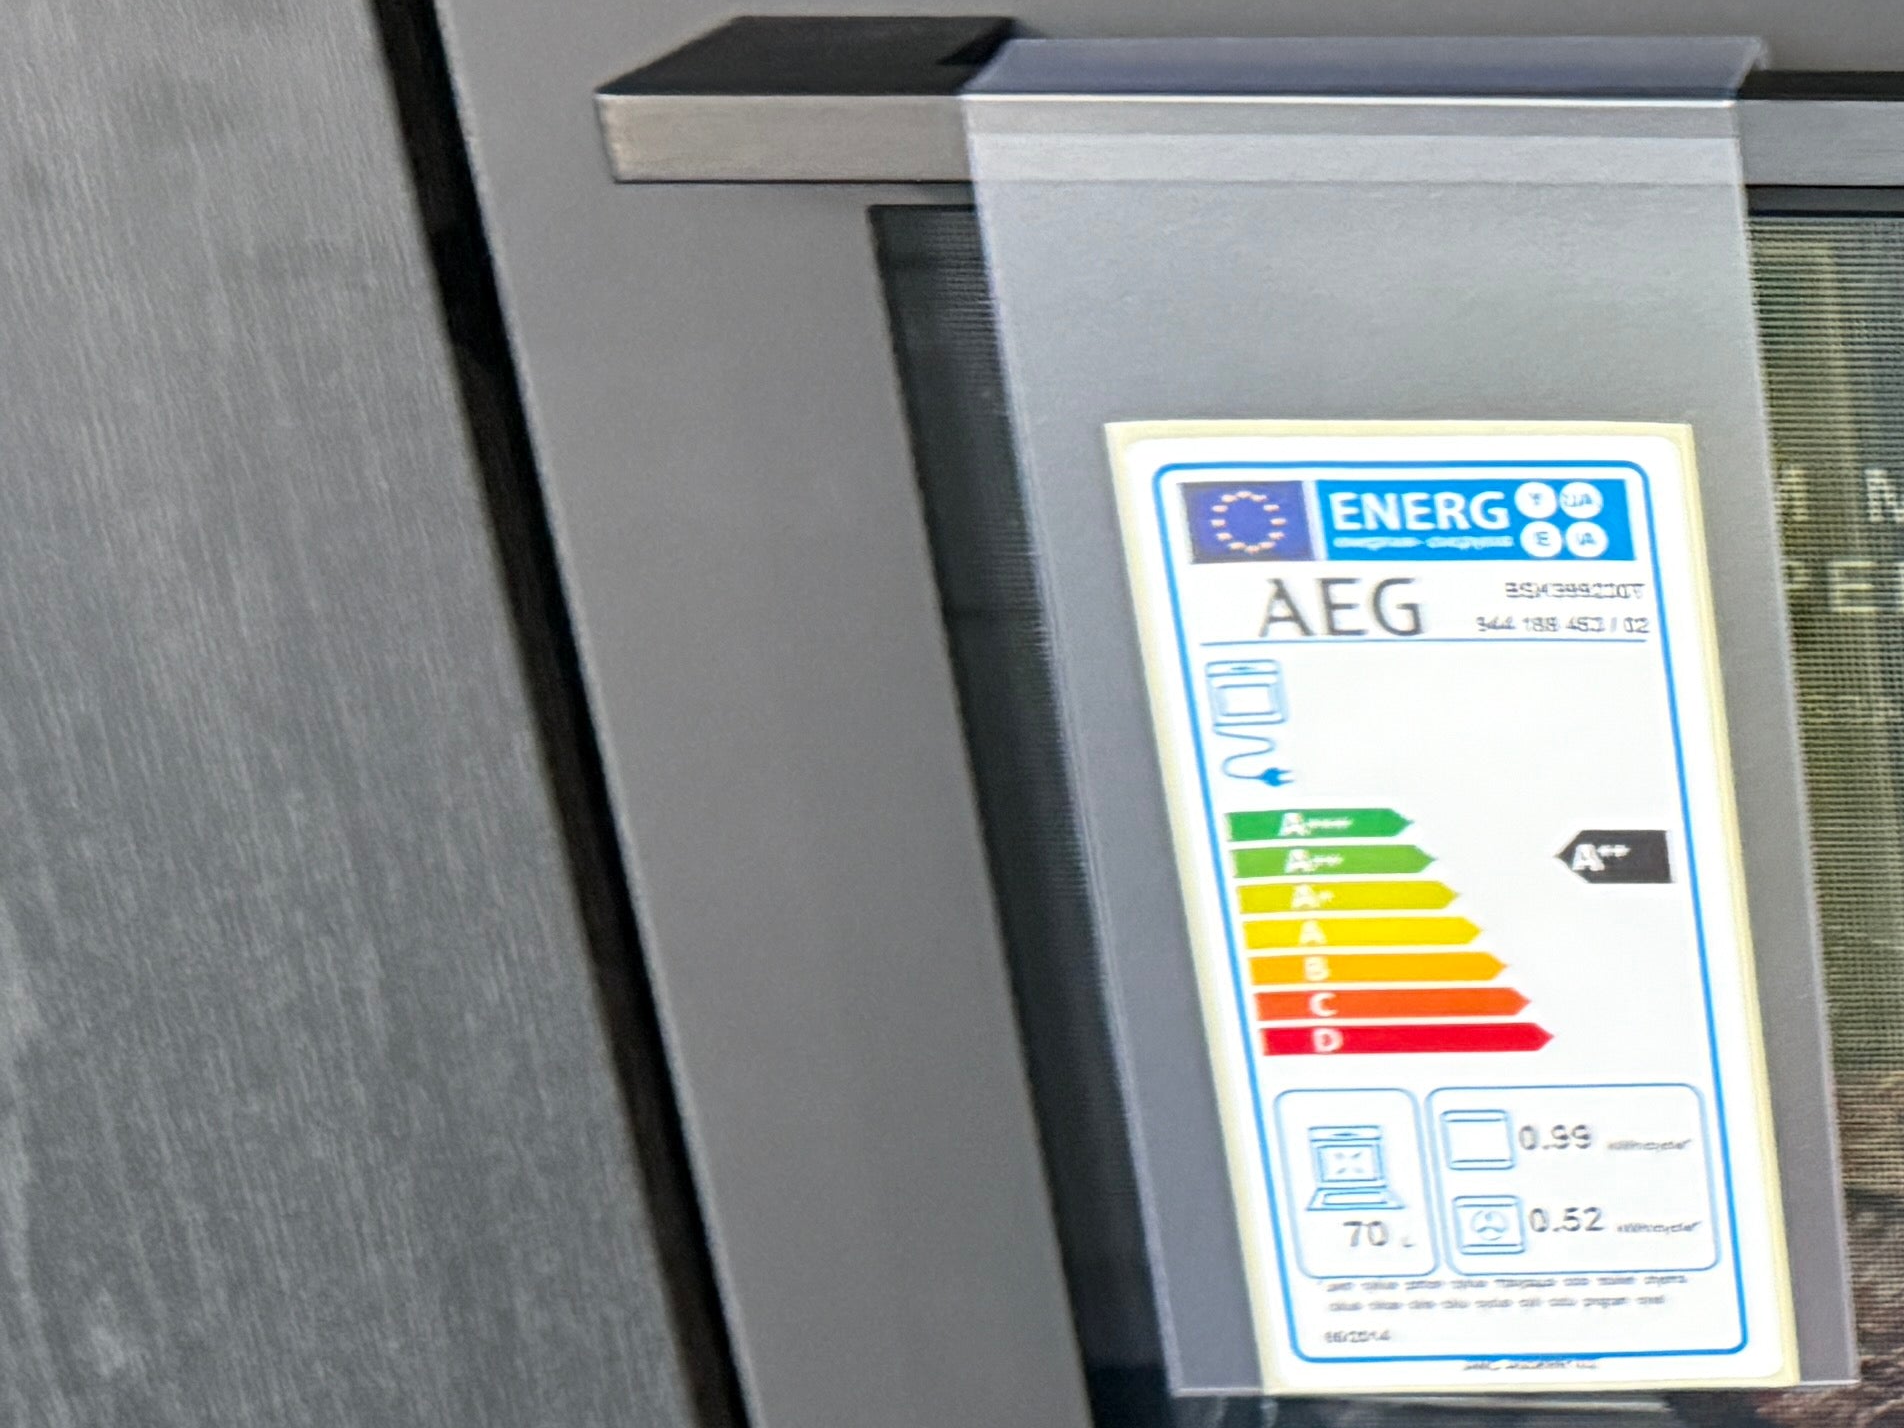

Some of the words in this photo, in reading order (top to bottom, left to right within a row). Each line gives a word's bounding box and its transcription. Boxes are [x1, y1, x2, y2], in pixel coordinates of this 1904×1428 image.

[1328, 490, 1510, 531] ENERG
[1258, 576, 1425, 637] AEG
[1572, 843, 1631, 872] A++
[1299, 919, 1327, 946] A
[1304, 956, 1330, 981] B
[1309, 992, 1338, 1017] C
[1312, 1028, 1343, 1053] D
[1518, 1123, 1593, 1152] 0.99
[1528, 1206, 1605, 1233] 0.52
[1342, 1220, 1389, 1248] 70
